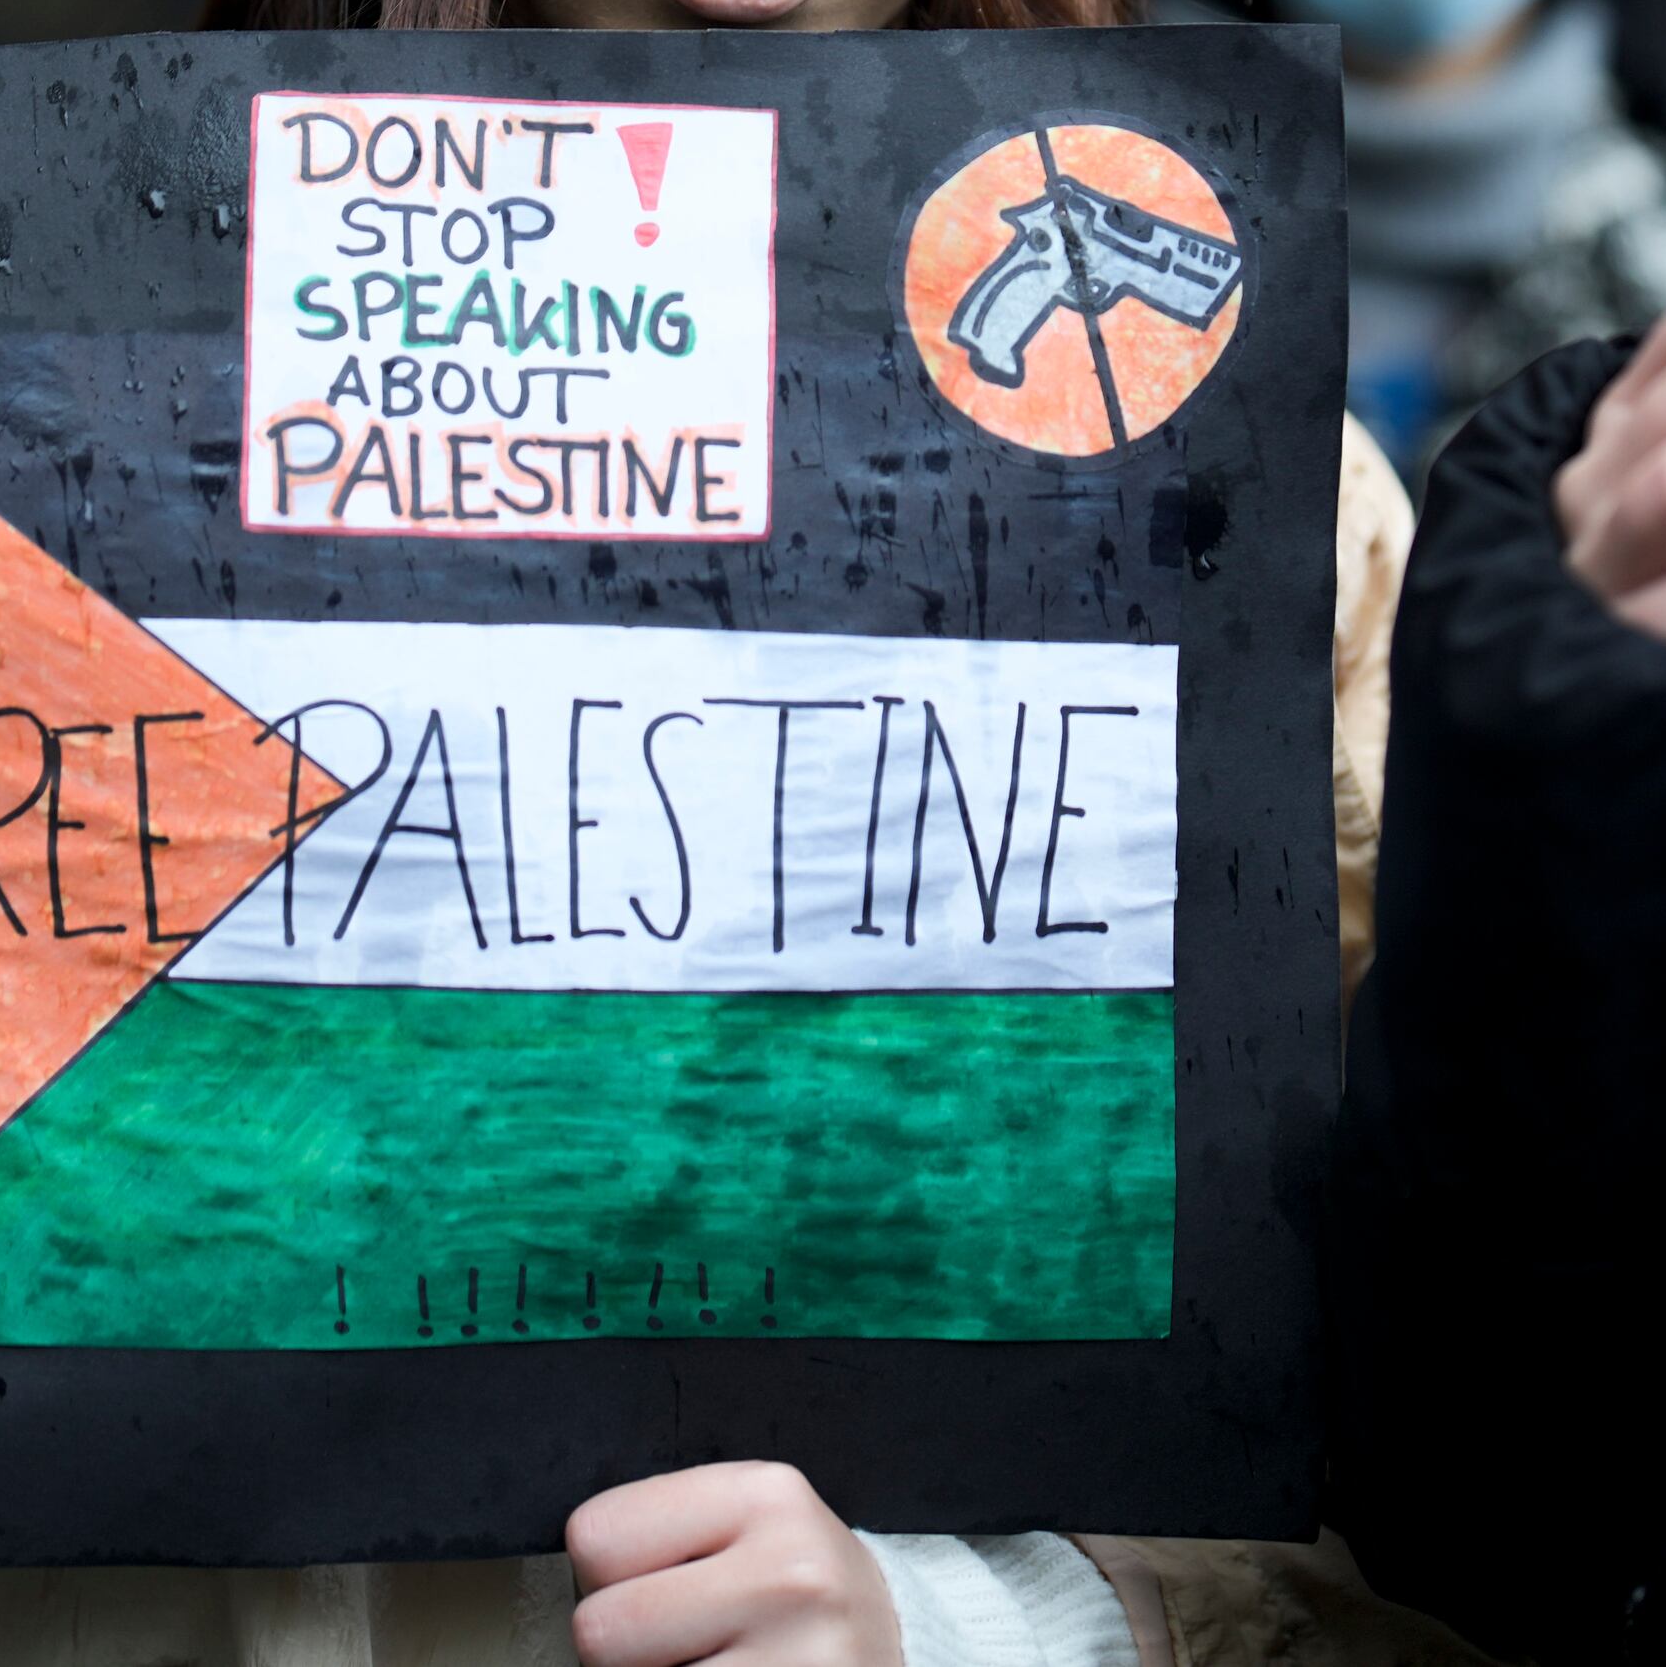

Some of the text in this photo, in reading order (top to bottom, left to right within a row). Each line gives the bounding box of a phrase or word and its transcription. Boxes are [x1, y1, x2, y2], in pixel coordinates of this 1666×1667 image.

[282, 112, 595, 192] DON'T
[335, 197, 556, 270] STOP
[293, 269, 697, 357] SPEAKING
[325, 354, 610, 424] ABOUT
[263, 414, 743, 524] PALESTINE
[251, 694, 1139, 954] PALESTINE
